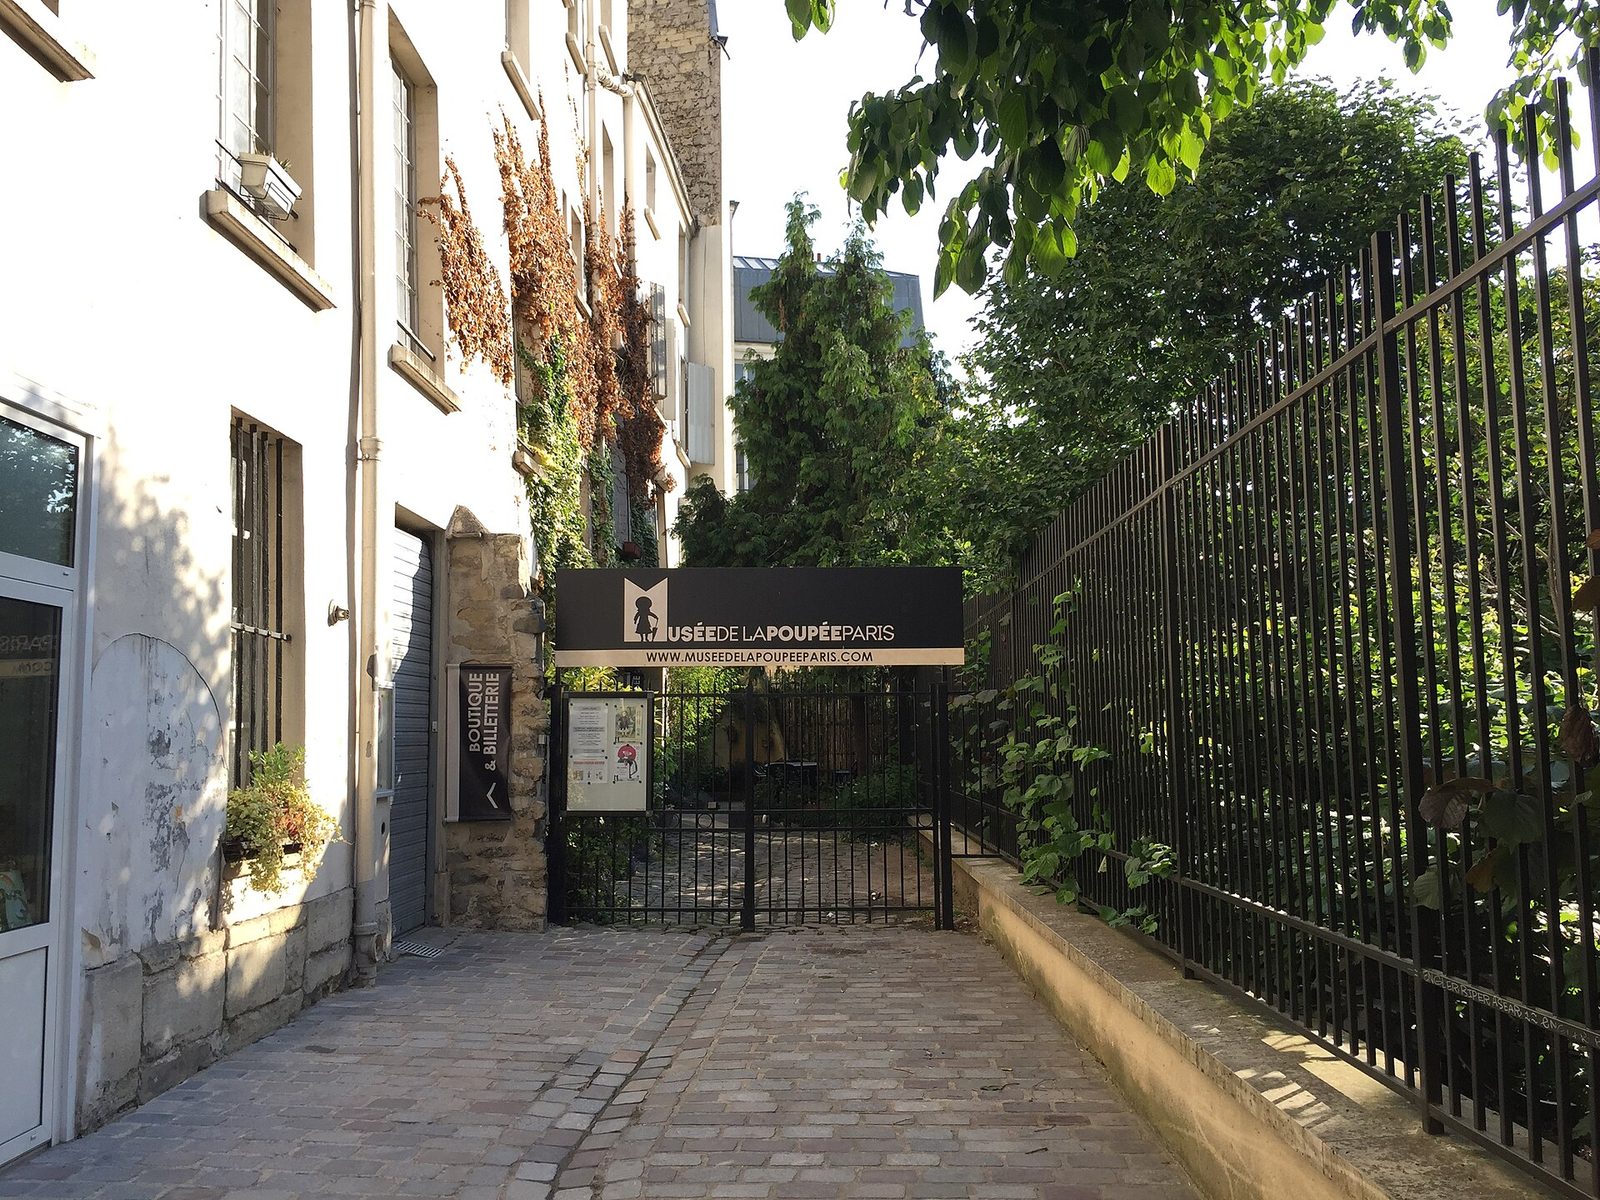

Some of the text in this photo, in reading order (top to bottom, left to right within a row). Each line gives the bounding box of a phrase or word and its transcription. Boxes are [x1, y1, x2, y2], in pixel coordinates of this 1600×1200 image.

[646, 651, 873, 663] WWW.MUSEEDELAPOUPEEPARIS.COM
[468, 673, 483, 752] BOUTIQUE
[483, 673, 500, 771] & BILLETTERIE
